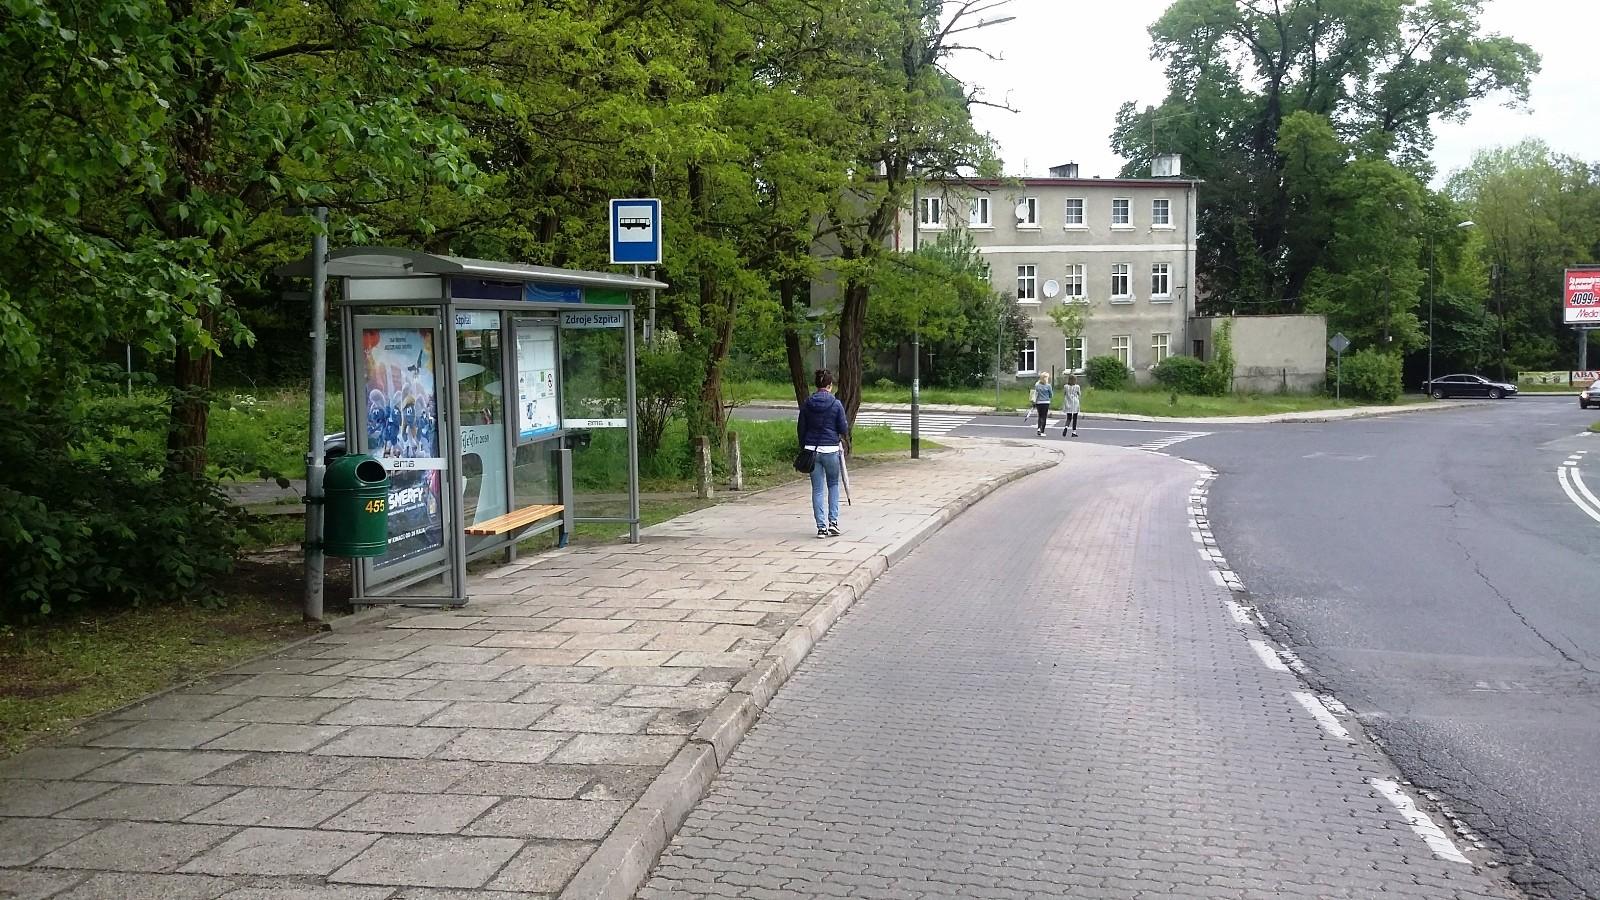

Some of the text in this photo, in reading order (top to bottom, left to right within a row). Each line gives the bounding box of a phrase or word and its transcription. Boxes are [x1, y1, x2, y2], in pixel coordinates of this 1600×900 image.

[565, 314, 621, 326] Zdroje Szpital
[388, 487, 423, 510] SMERFY
[365, 499, 385, 513] 455
